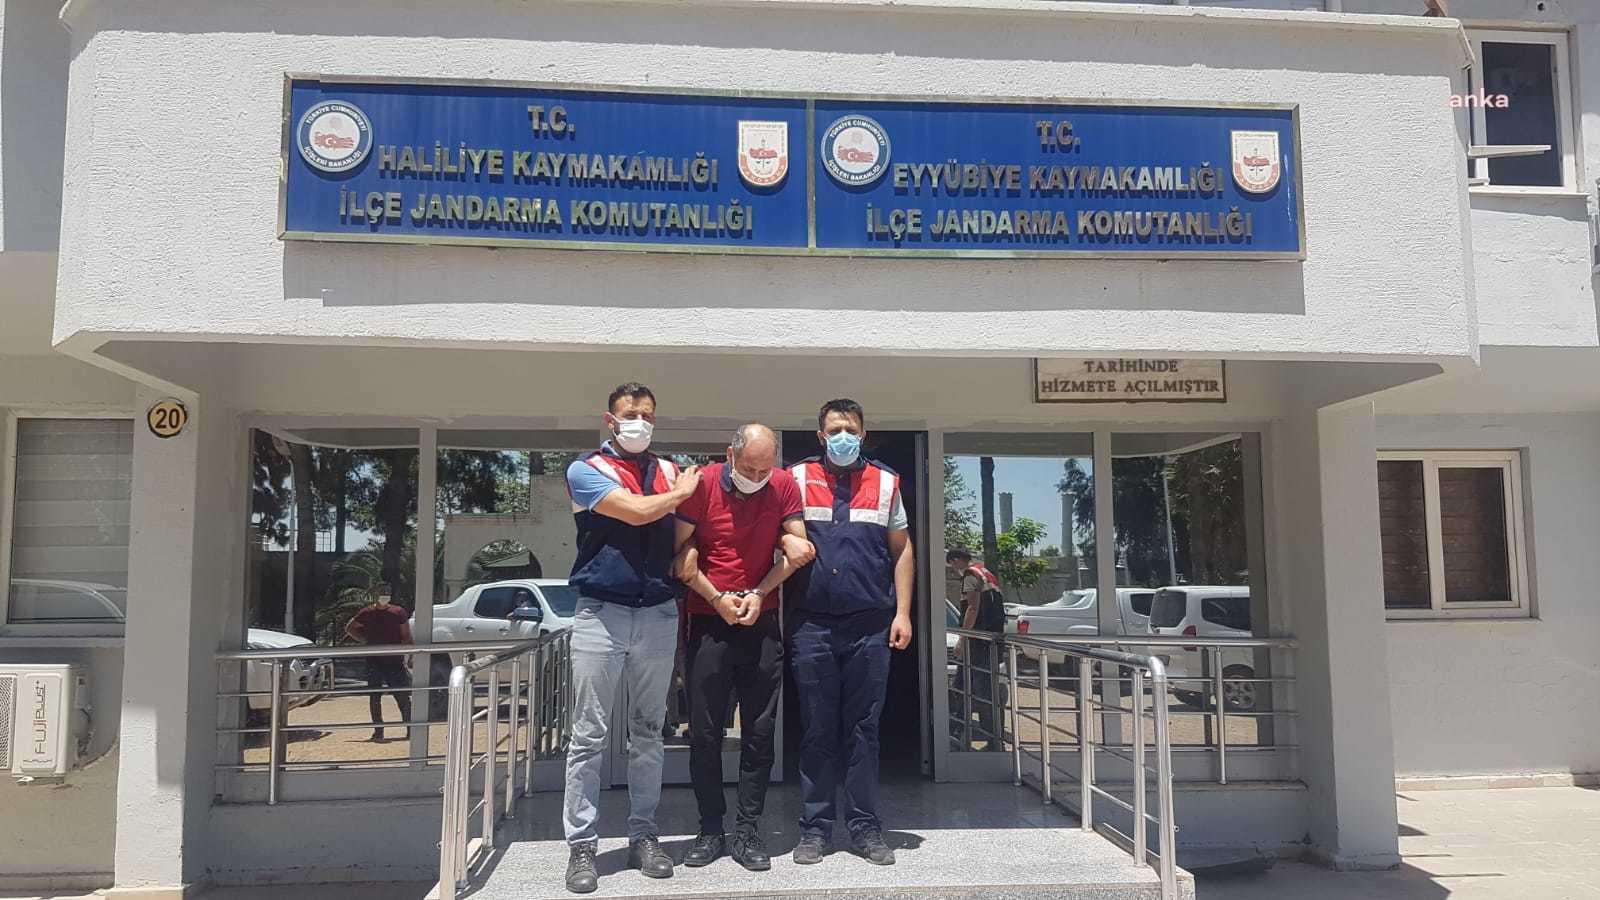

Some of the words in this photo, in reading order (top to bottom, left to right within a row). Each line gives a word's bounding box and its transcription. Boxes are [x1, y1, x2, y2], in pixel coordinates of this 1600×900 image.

[528, 105, 575, 132] T.C.
[1036, 120, 1081, 145] T.C.
[379, 140, 504, 175] HALİLİYE
[512, 150, 718, 184] KAYMAKAMLIĞI
[893, 159, 1021, 189] EYYÜBİYE
[1029, 161, 1224, 192] KAYMAKAMLIĞI
[339, 185, 402, 224] İLÇE
[410, 193, 562, 224] JANDARMA
[570, 199, 753, 230] KOMUTANLIĞI
[867, 202, 922, 240] İLÇE
[930, 208, 1070, 235] JANDARMA
[1077, 206, 1252, 236] KOMUTANLIĞI
[1084, 358, 1178, 373] TARİHİNDE
[1041, 377, 1116, 393] HİZMETE
[1124, 379, 1220, 395] AÇILMIŞTIR
[155, 408, 180, 429] 20
